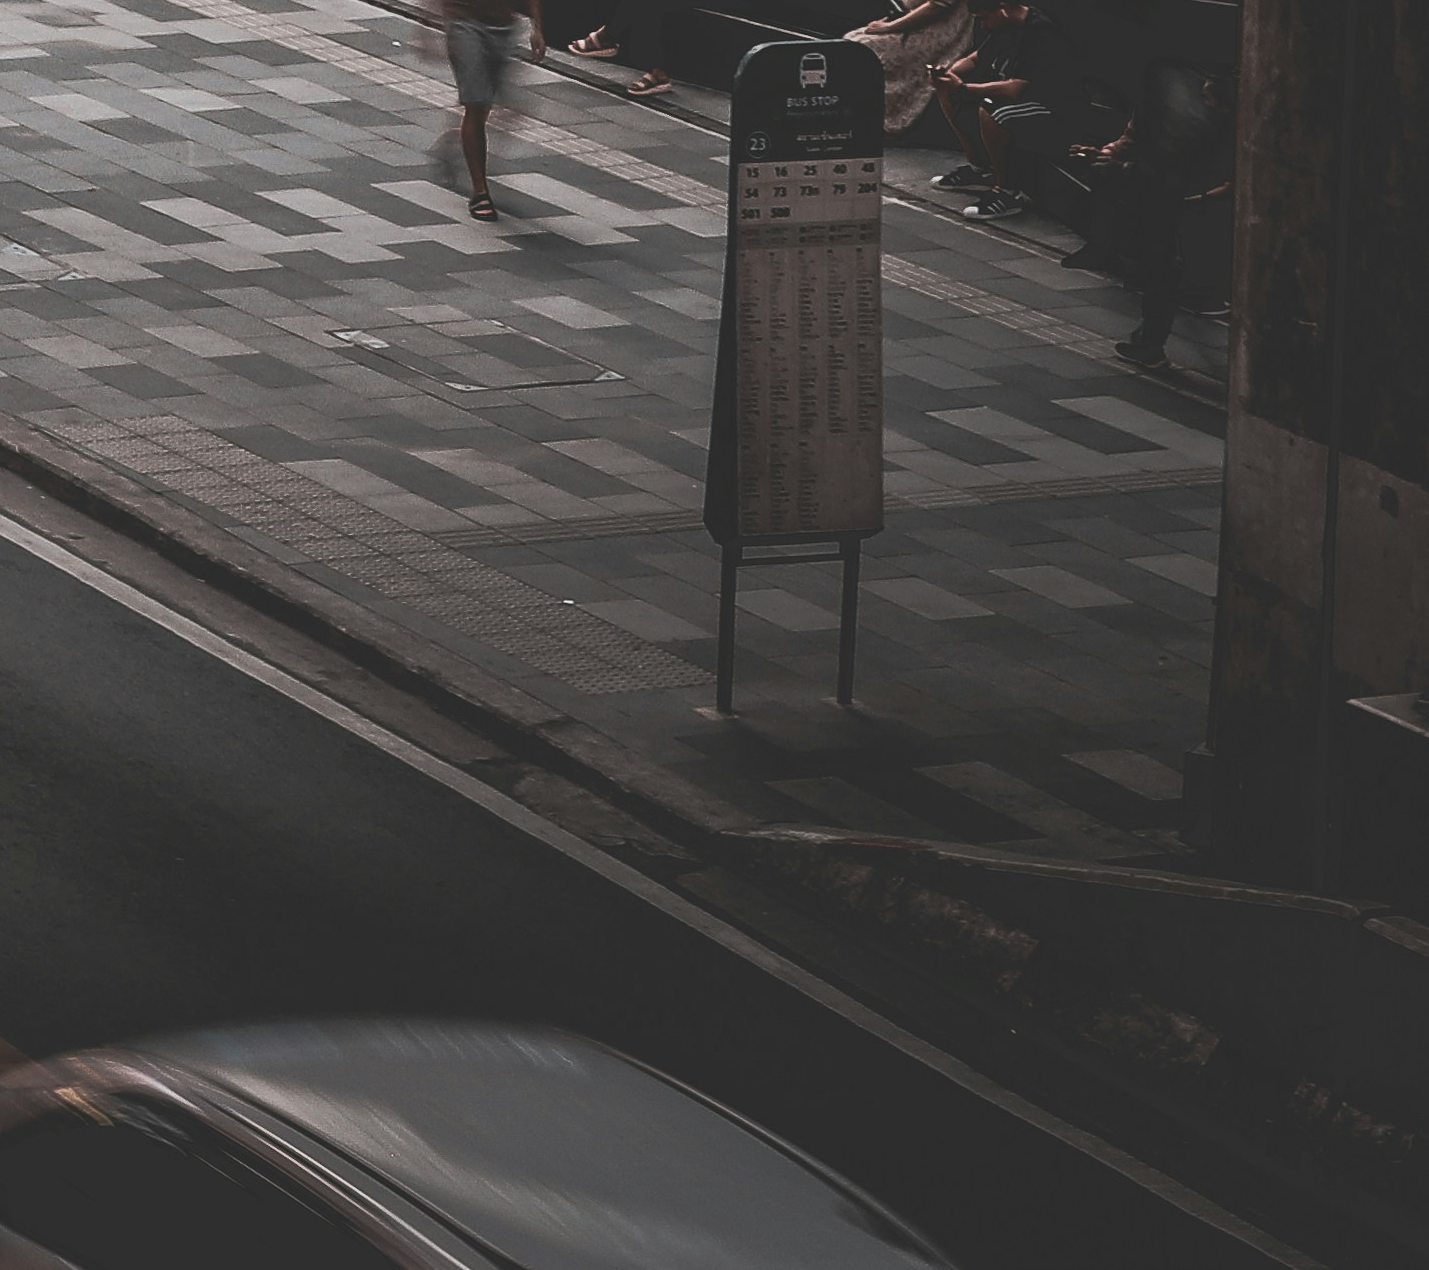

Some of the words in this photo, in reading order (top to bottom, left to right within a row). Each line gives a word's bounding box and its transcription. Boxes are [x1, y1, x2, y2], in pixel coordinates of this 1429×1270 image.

[786, 97, 808, 108] BUS
[811, 95, 840, 106] STOP
[749, 137, 767, 152] 23
